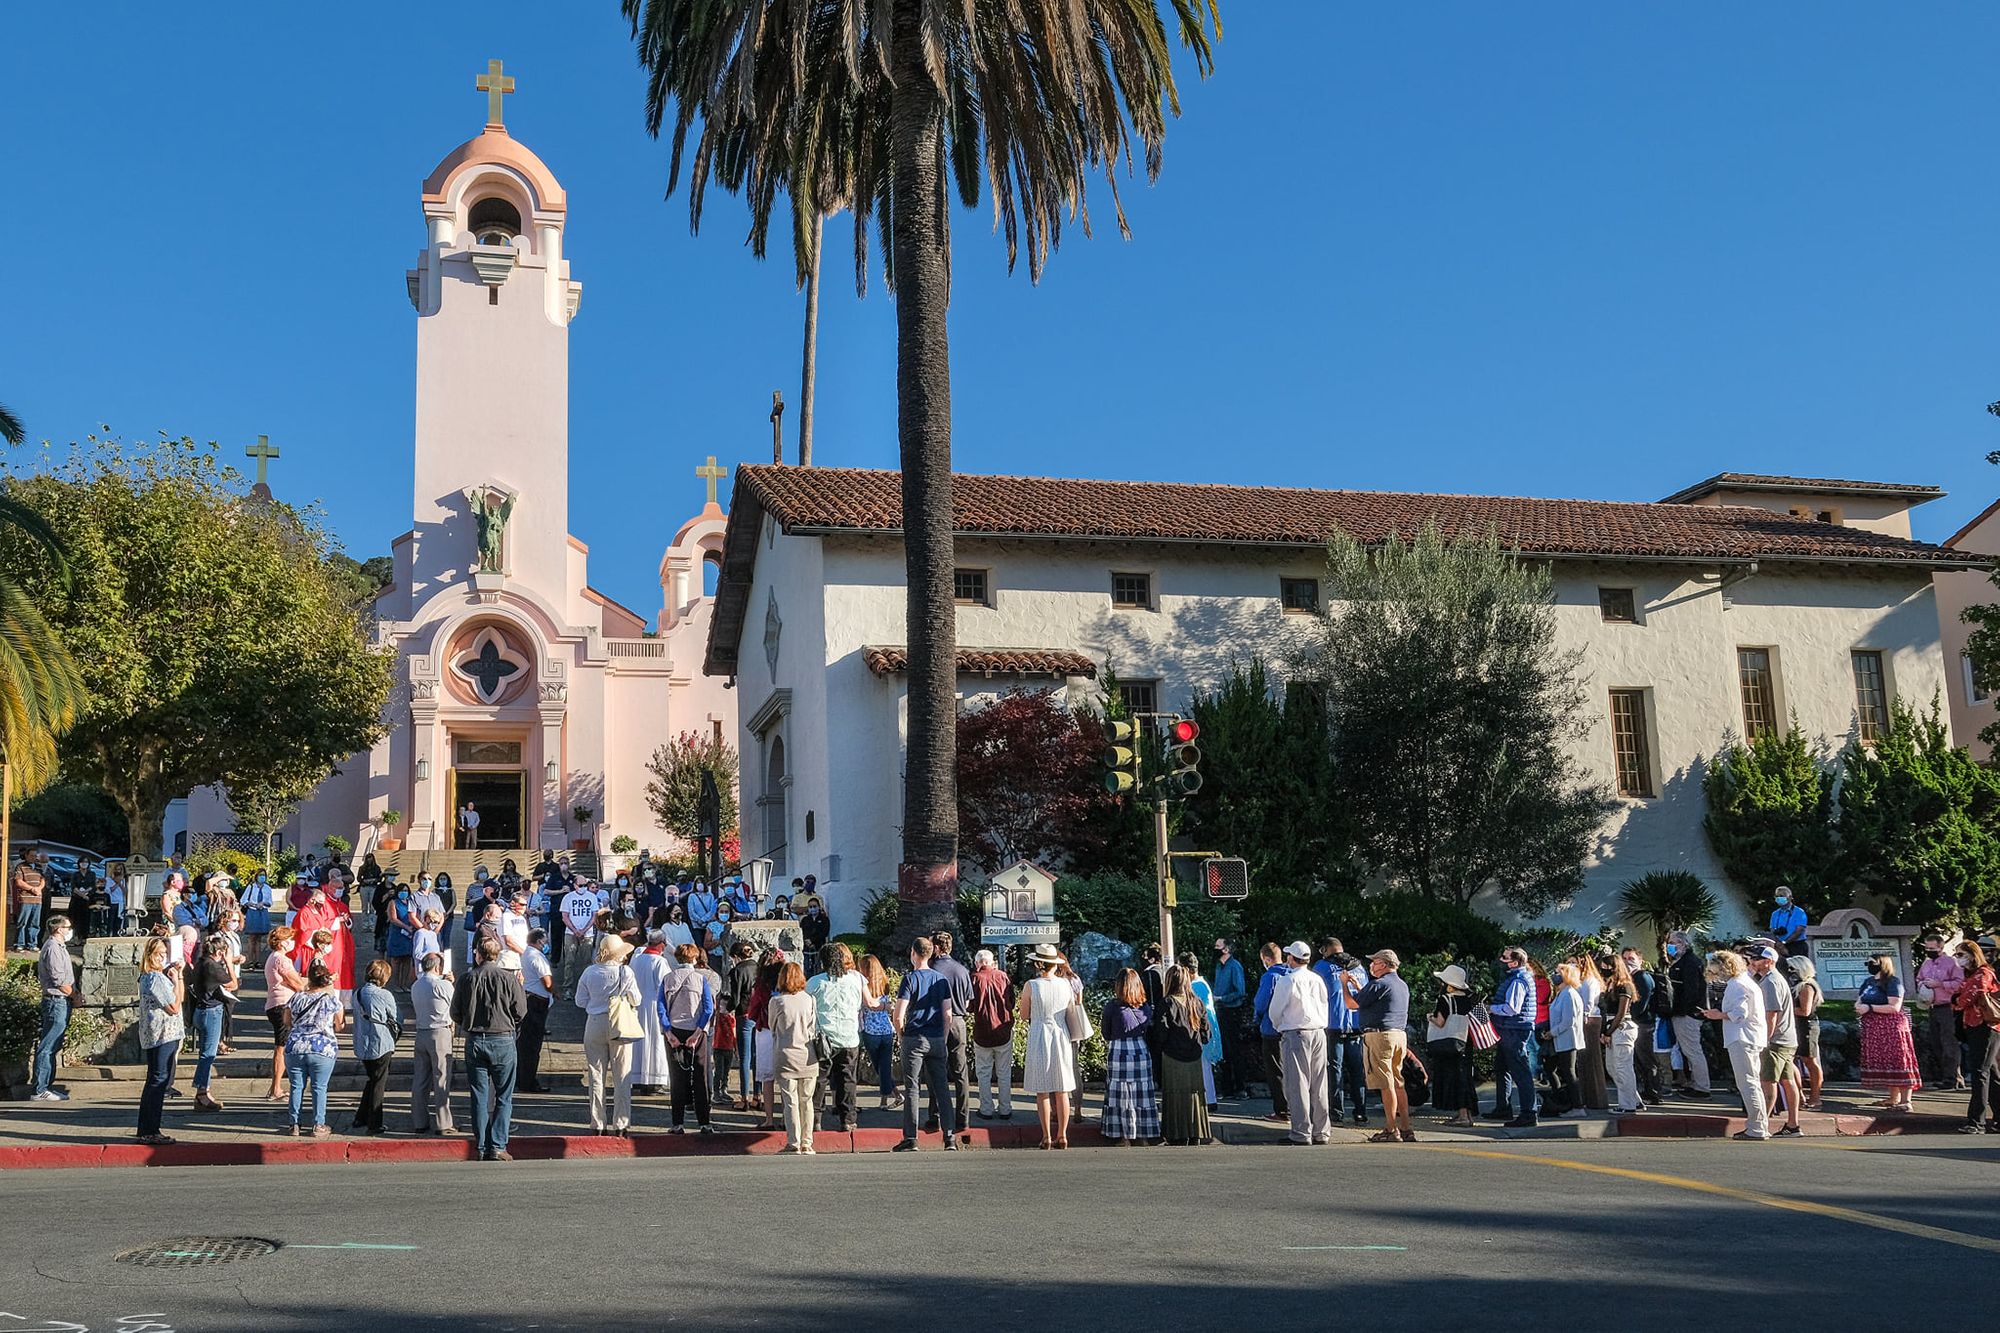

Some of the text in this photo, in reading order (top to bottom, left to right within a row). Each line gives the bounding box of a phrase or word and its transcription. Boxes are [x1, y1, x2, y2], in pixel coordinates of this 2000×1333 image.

[572, 899, 592, 908] PRO
[572, 908, 591, 917] LIFE
[984, 926, 1018, 935] Founded
[1843, 941, 1850, 949] OF
[1851, 941, 1867, 949] SAINT
